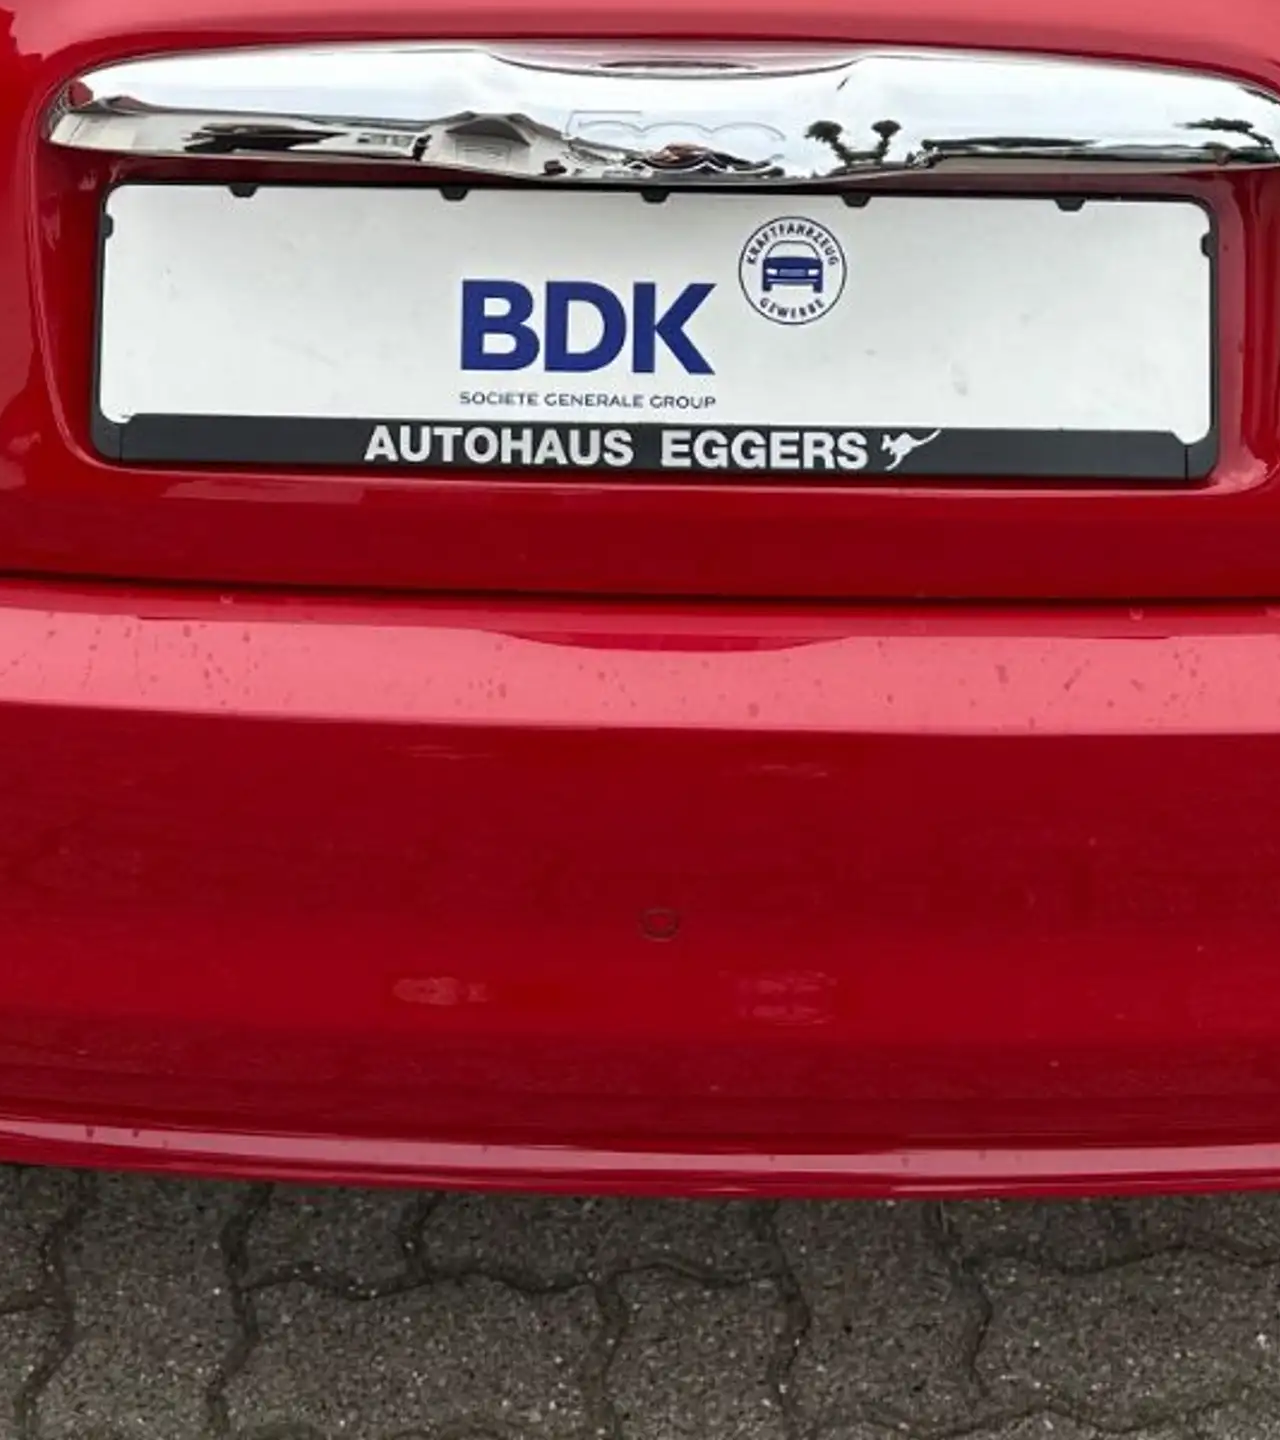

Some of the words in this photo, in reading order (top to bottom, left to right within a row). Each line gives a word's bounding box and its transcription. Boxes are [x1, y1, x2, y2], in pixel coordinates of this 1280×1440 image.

[745, 222, 840, 266] KRAFTFAHRZEUG
[460, 279, 718, 376] BDK
[759, 297, 825, 318] GEWERBE
[543, 392, 644, 408] GENERALE
[649, 394, 717, 410] GROUP
[363, 424, 634, 467] AUTOHAUS
[660, 428, 869, 472] EGGERS
